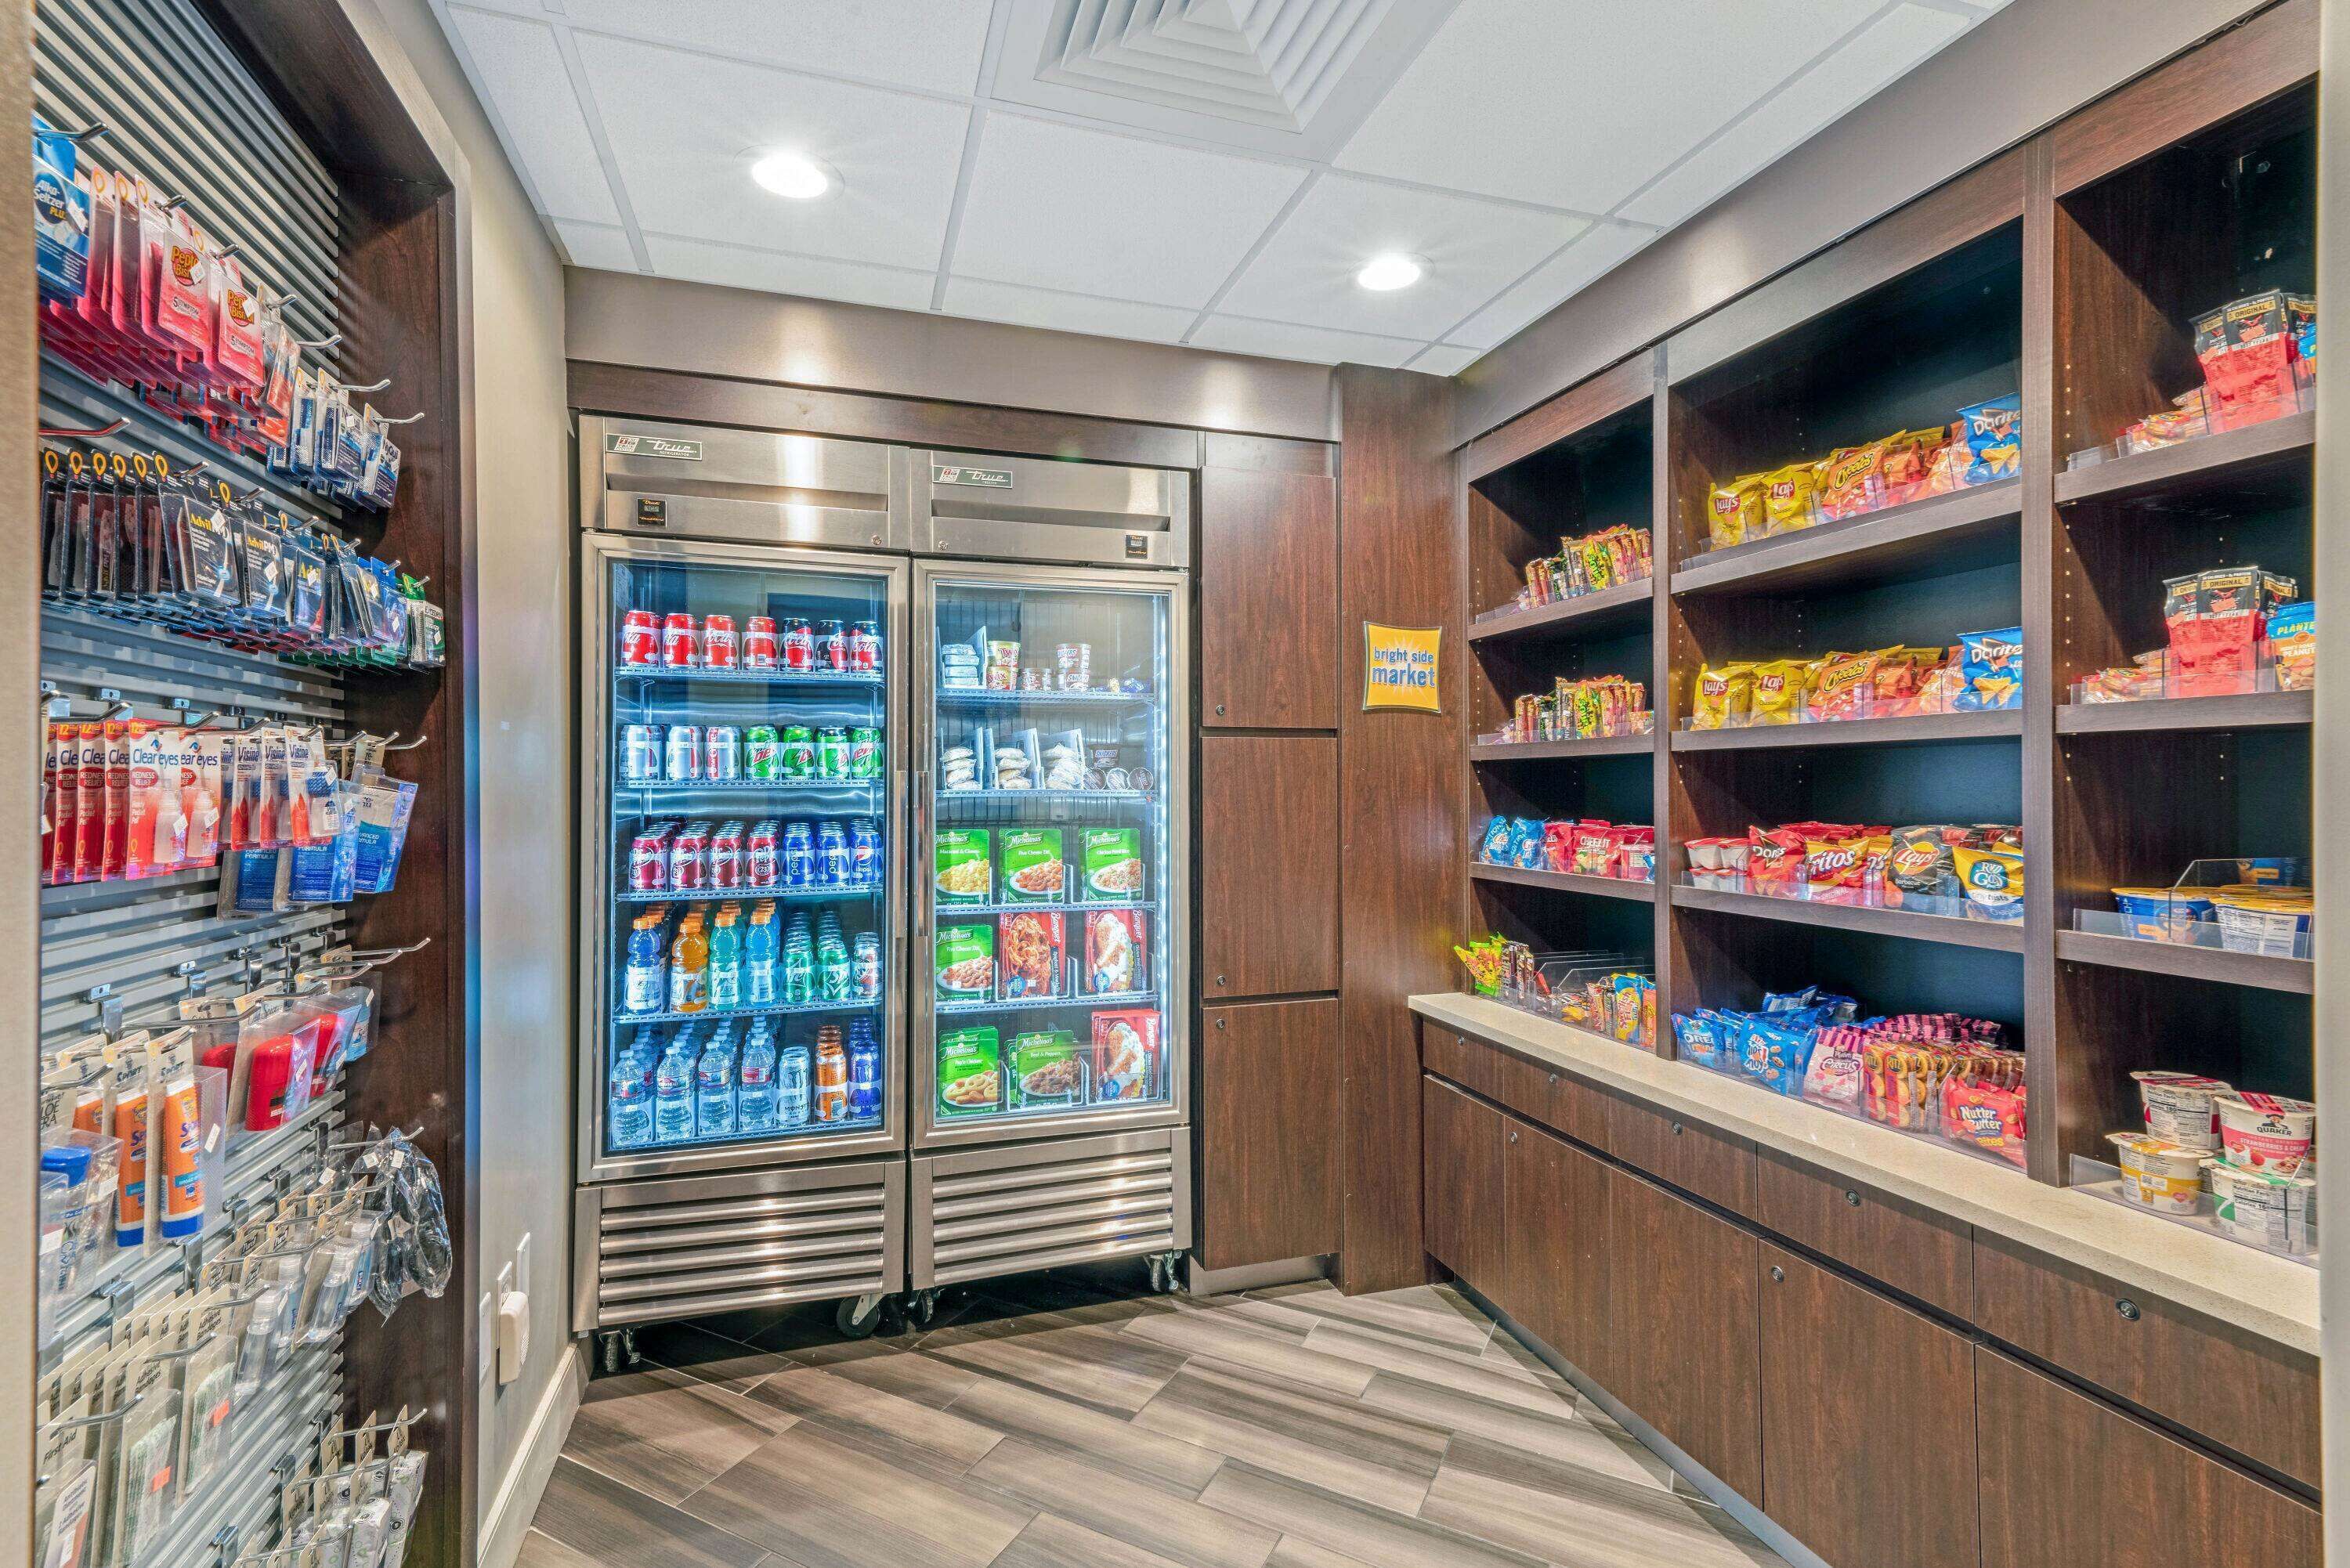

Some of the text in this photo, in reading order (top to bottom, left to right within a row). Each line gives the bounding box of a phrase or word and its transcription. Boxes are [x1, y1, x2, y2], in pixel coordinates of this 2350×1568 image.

[33, 188, 65, 208] Seltzer
[2234, 305, 2267, 318] ORIGINAL
[1834, 453, 1874, 490] Cheetos
[1716, 494, 1737, 514] Lay's
[2209, 578, 2243, 587] ORIGINAL
[1374, 646, 1434, 663] bright side
[1971, 644, 2023, 663] Dorito
[2283, 647, 2315, 658] PEANUT
[1372, 663, 1435, 687] market
[1824, 661, 1868, 692] Cheetos
[1704, 680, 1727, 696] Lay's
[59, 724, 70, 735] 12
[133, 749, 179, 770] Clear eyes
[237, 746, 261, 762] Visine
[288, 744, 309, 759] Visine
[196, 754, 218, 770] eyes
[1009, 835, 1042, 847] Michelina's
[1089, 834, 1121, 845] Michelina's
[789, 847, 801, 876] pepsi
[1809, 850, 1856, 876] Fritos
[1896, 849, 1934, 867] Lay's
[1050, 912, 1061, 944] Banquet
[1133, 909, 1142, 941] Banquet
[937, 930, 971, 943] Michelina's
[1146, 1017, 1156, 1048] Banquet
[1684, 1032, 1712, 1044] ORE
[1018, 1038, 1054, 1050] Michelina's
[942, 1046, 977, 1059] Michelina's
[1959, 1106, 1996, 1120] Nutter
[2256, 1126, 2293, 1136] QUAKER
[2240, 1137, 2282, 1151] STRAWBERRIES
[2235, 1198, 2257, 1208] Calories
[41, 1428, 78, 1465] First Aid
